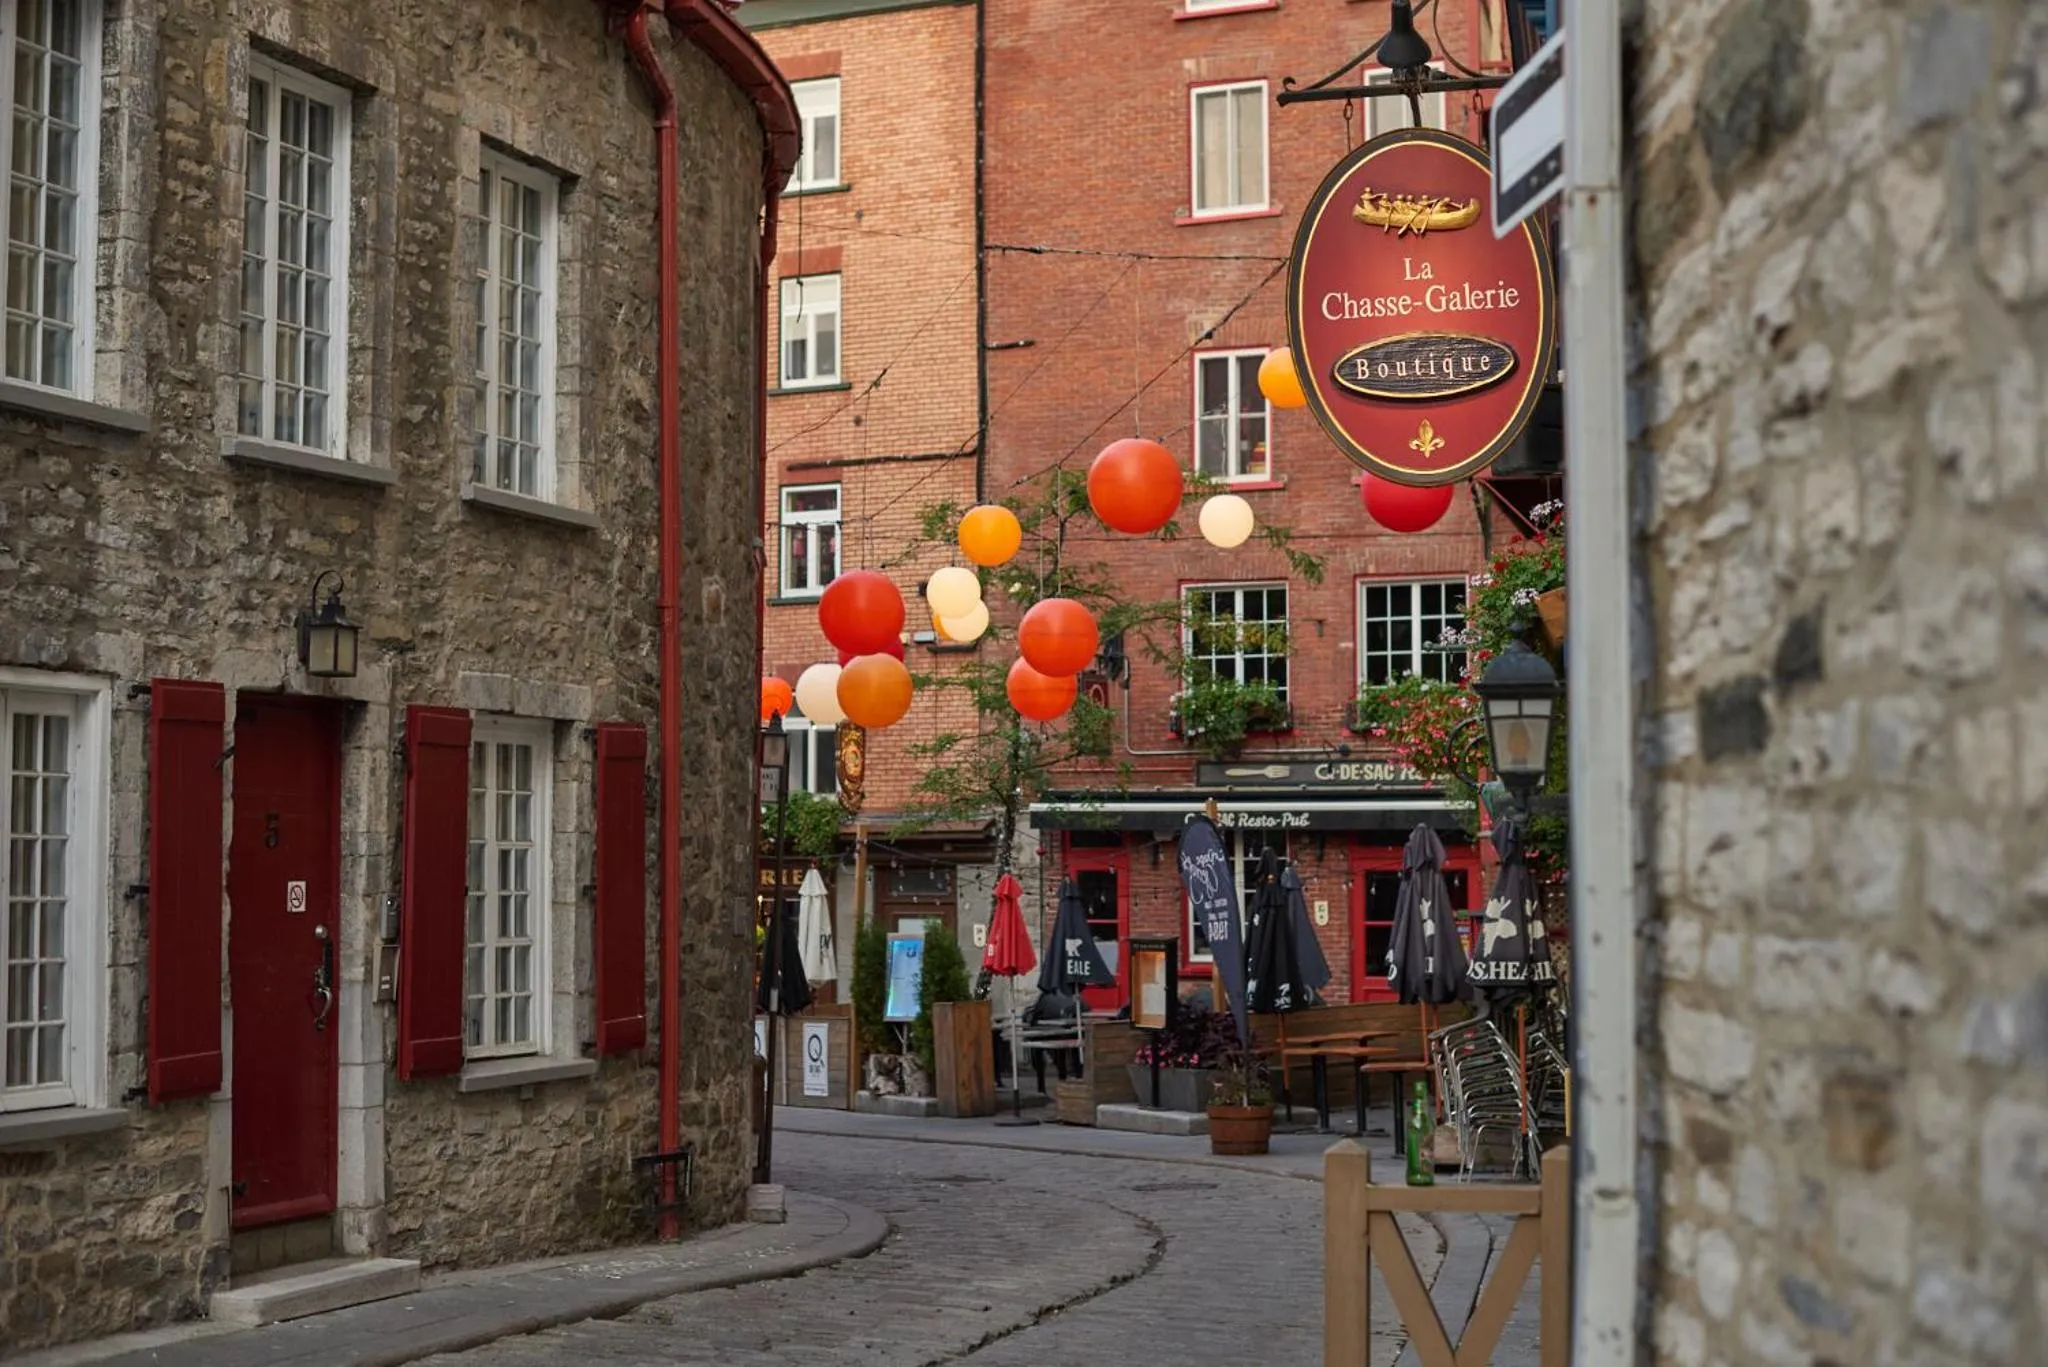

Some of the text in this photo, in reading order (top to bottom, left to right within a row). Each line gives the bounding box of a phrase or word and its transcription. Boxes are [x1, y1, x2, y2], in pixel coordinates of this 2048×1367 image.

[1404, 257, 1434, 281] La
[1321, 280, 1520, 321] Chasse-Galerie
[1356, 353, 1491, 380] Boutique
[1238, 812, 1311, 828] Resto-Pub
